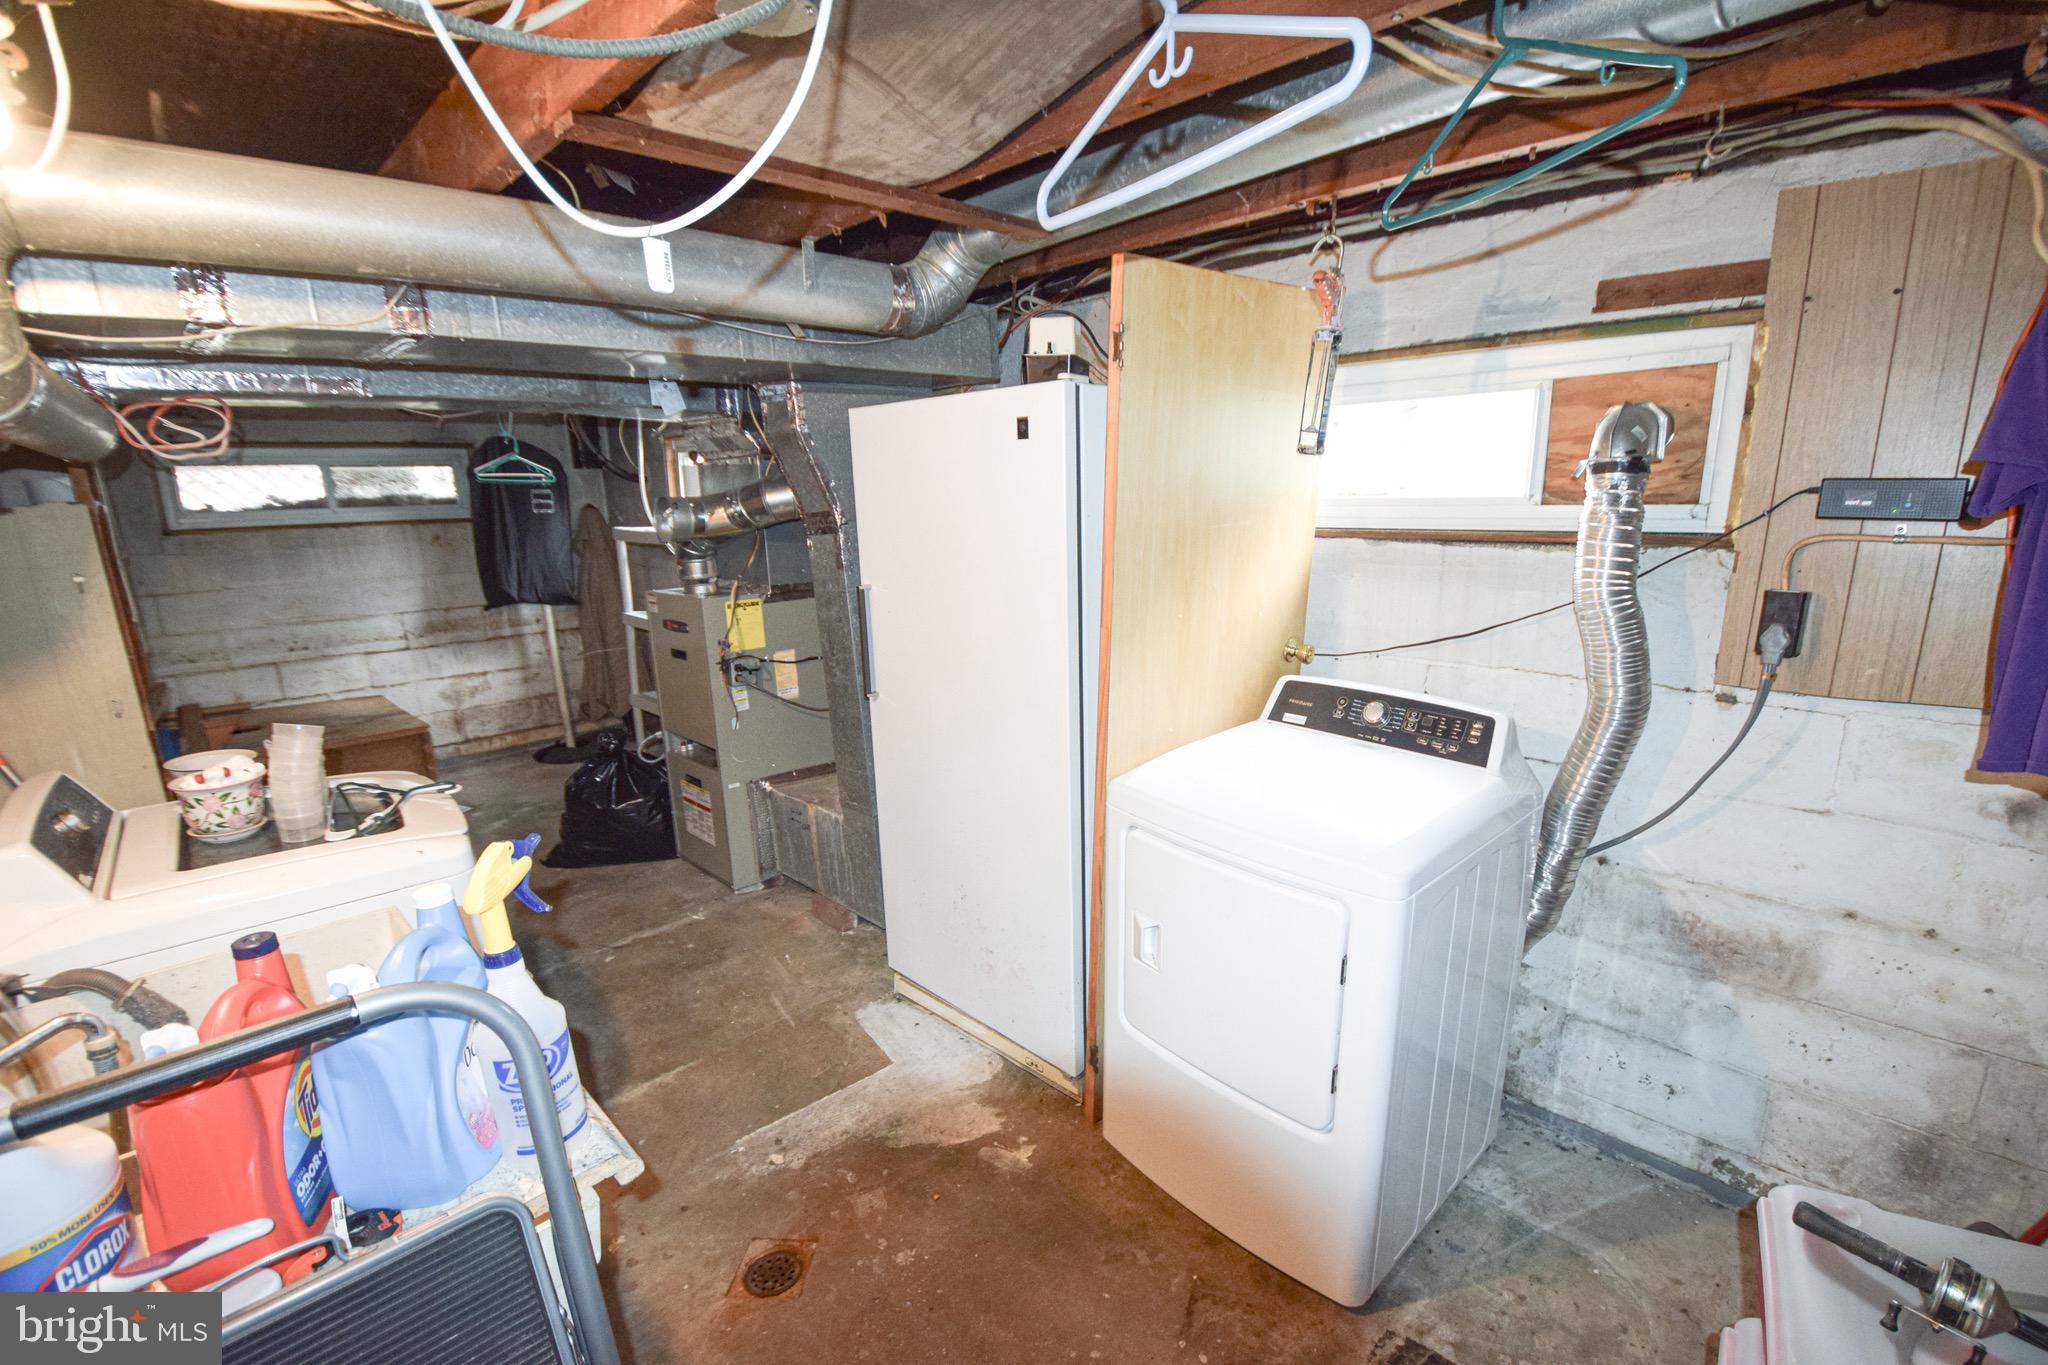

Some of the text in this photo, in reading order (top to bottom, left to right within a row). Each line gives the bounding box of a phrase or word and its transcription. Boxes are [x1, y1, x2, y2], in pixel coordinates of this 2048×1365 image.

[298, 1073, 319, 1134] Tid
[29, 1236, 58, 1255] 50%
[58, 1212, 94, 1240] MORE
[55, 1218, 131, 1292] CLOROX
